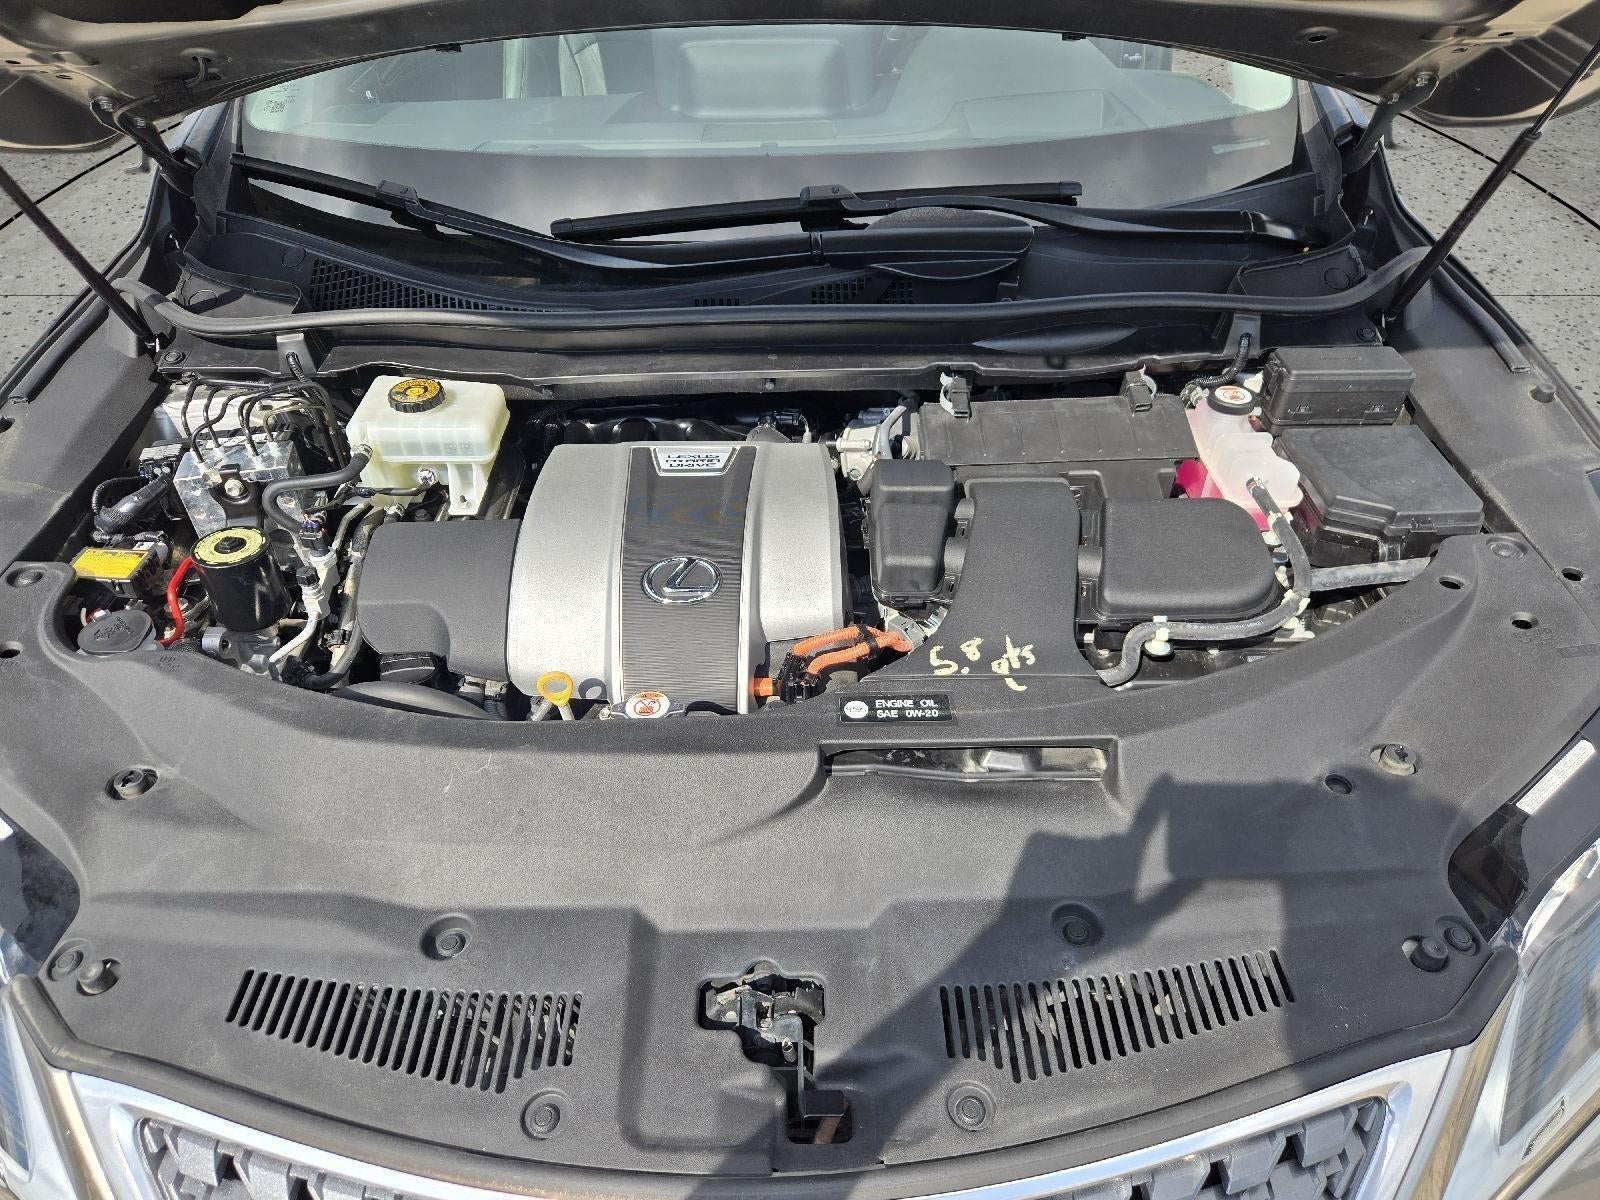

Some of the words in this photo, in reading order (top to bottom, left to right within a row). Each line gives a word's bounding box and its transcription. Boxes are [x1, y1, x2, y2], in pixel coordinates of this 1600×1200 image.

[875, 699, 914, 708] ENGINE
[919, 699, 939, 708] OIL
[876, 709, 899, 718] SAE
[905, 709, 939, 718] 0W-20
